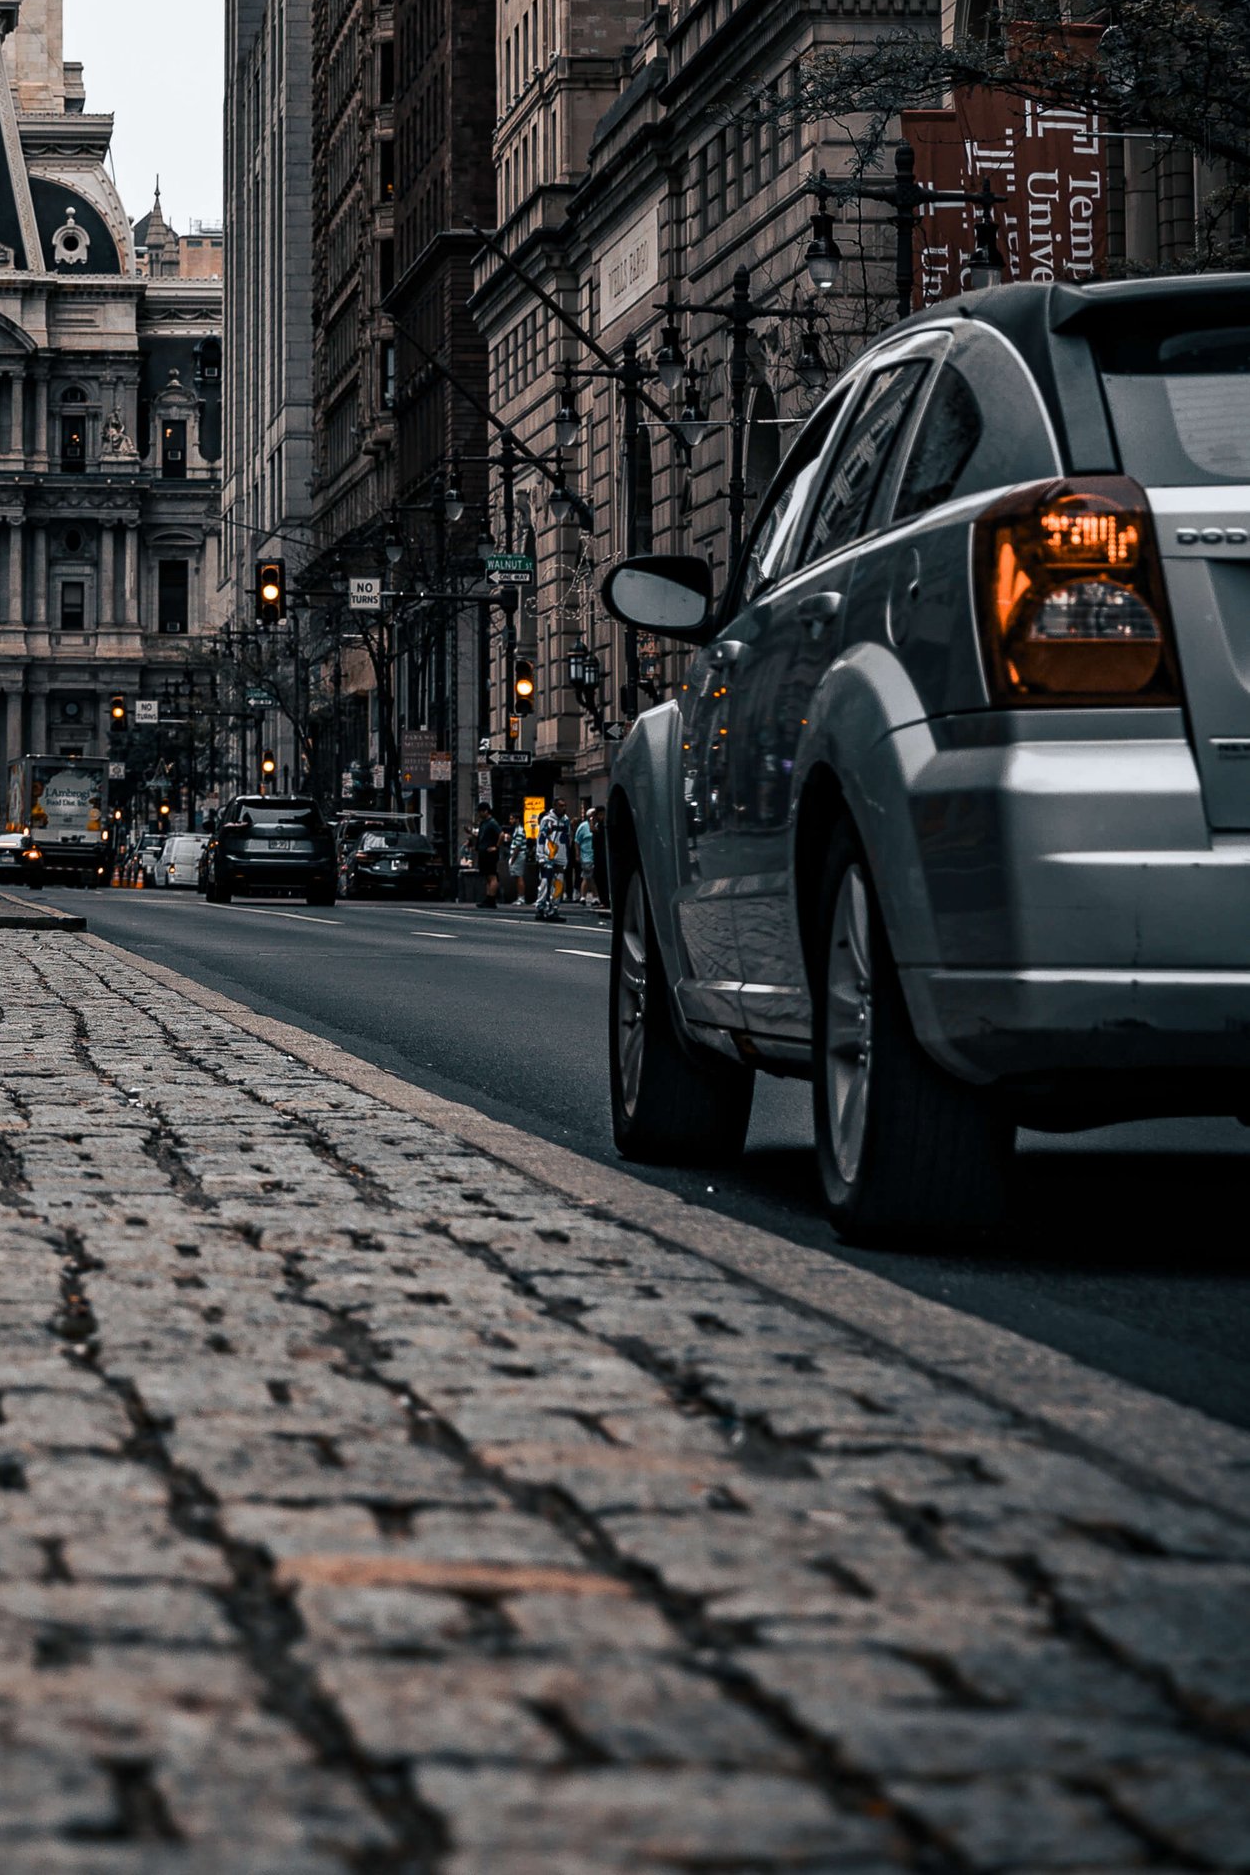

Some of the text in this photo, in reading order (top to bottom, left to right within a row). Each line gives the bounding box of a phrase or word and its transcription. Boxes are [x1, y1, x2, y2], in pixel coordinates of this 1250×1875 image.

[487, 560, 523, 570] WALNUT
[357, 582, 373, 593] NO
[352, 595, 378, 604] TURNS
[141, 703, 152, 711] NO
